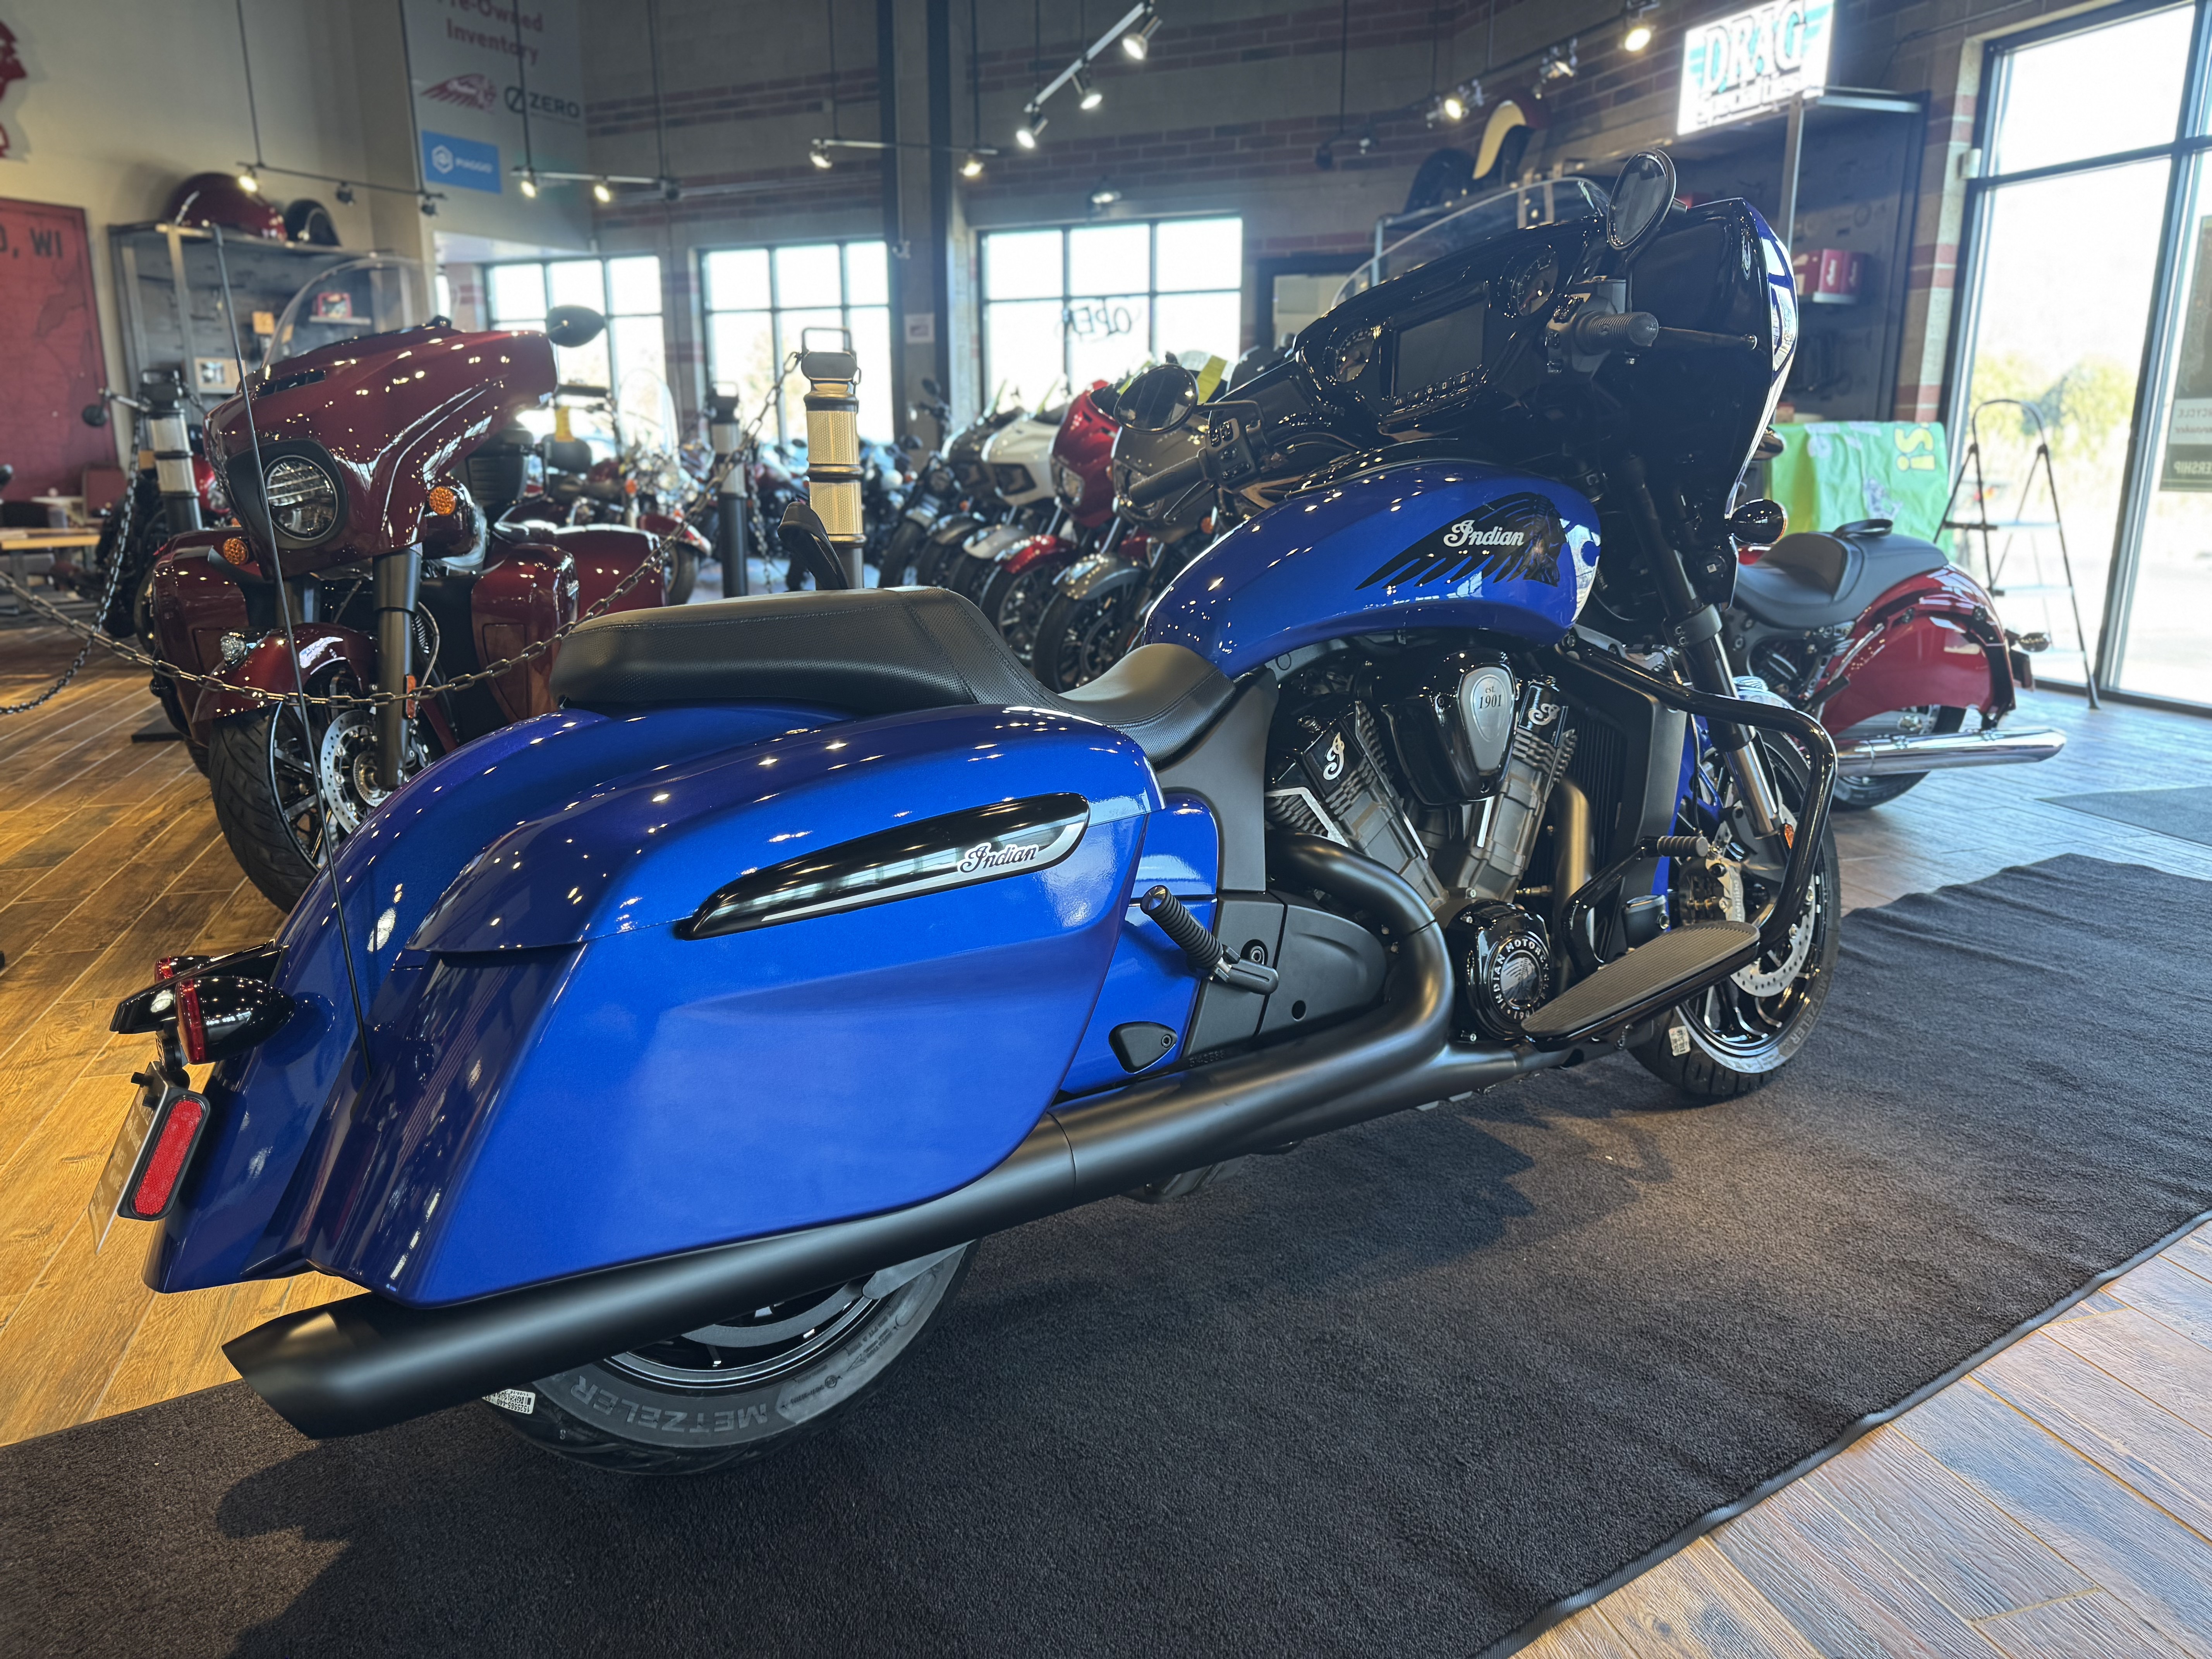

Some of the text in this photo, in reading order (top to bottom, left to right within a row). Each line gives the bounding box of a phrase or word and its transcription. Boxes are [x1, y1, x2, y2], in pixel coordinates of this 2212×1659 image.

[447, 17, 539, 66] Inventory
[1702, 0, 1806, 96] DRAG
[529, 91, 580, 118] ZERO
[29, 227, 63, 259] WI
[1443, 519, 1525, 547] Indian
[1478, 694, 1503, 710] 1901
[1484, 685, 1496, 694] est.
[958, 842, 1039, 874] Indian
[1493, 938, 1549, 1010] INDIAN MOTORCYCLE
[1791, 974, 1828, 1044] METZELER
[496, 1398, 529, 1413] 1525565-440
[570, 1375, 768, 1434] METZELER
